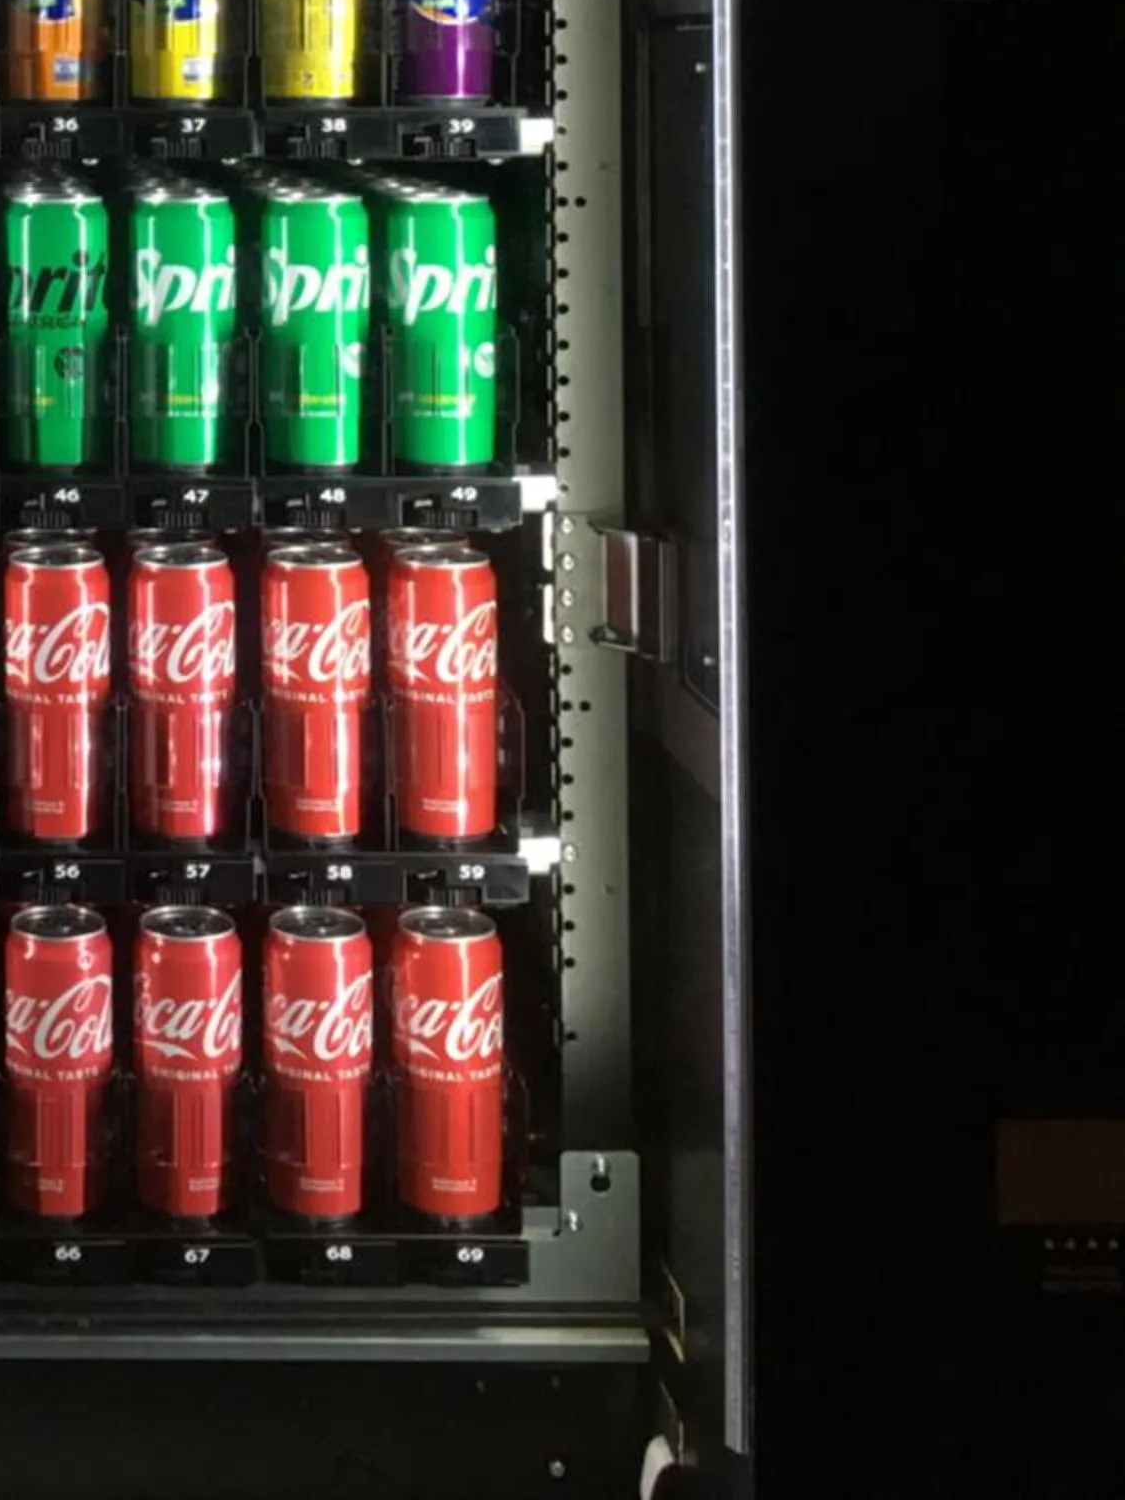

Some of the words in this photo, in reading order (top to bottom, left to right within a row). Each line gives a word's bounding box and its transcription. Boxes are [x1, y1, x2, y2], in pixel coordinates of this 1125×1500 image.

[54, 117, 79, 132] 36
[182, 117, 206, 133] 37
[322, 117, 347, 133] 38
[449, 118, 475, 134] 39
[54, 488, 80, 503] 46
[183, 489, 209, 504] 47
[319, 487, 346, 503] 48
[450, 486, 478, 502] 49
[55, 864, 80, 879] 56
[186, 863, 211, 879] 57
[327, 864, 353, 881] 58
[459, 864, 485, 880] 59
[55, 1245, 82, 1261] 66
[184, 1248, 210, 1264] 67
[326, 1245, 353, 1261] 68
[457, 1247, 484, 1262] 69
